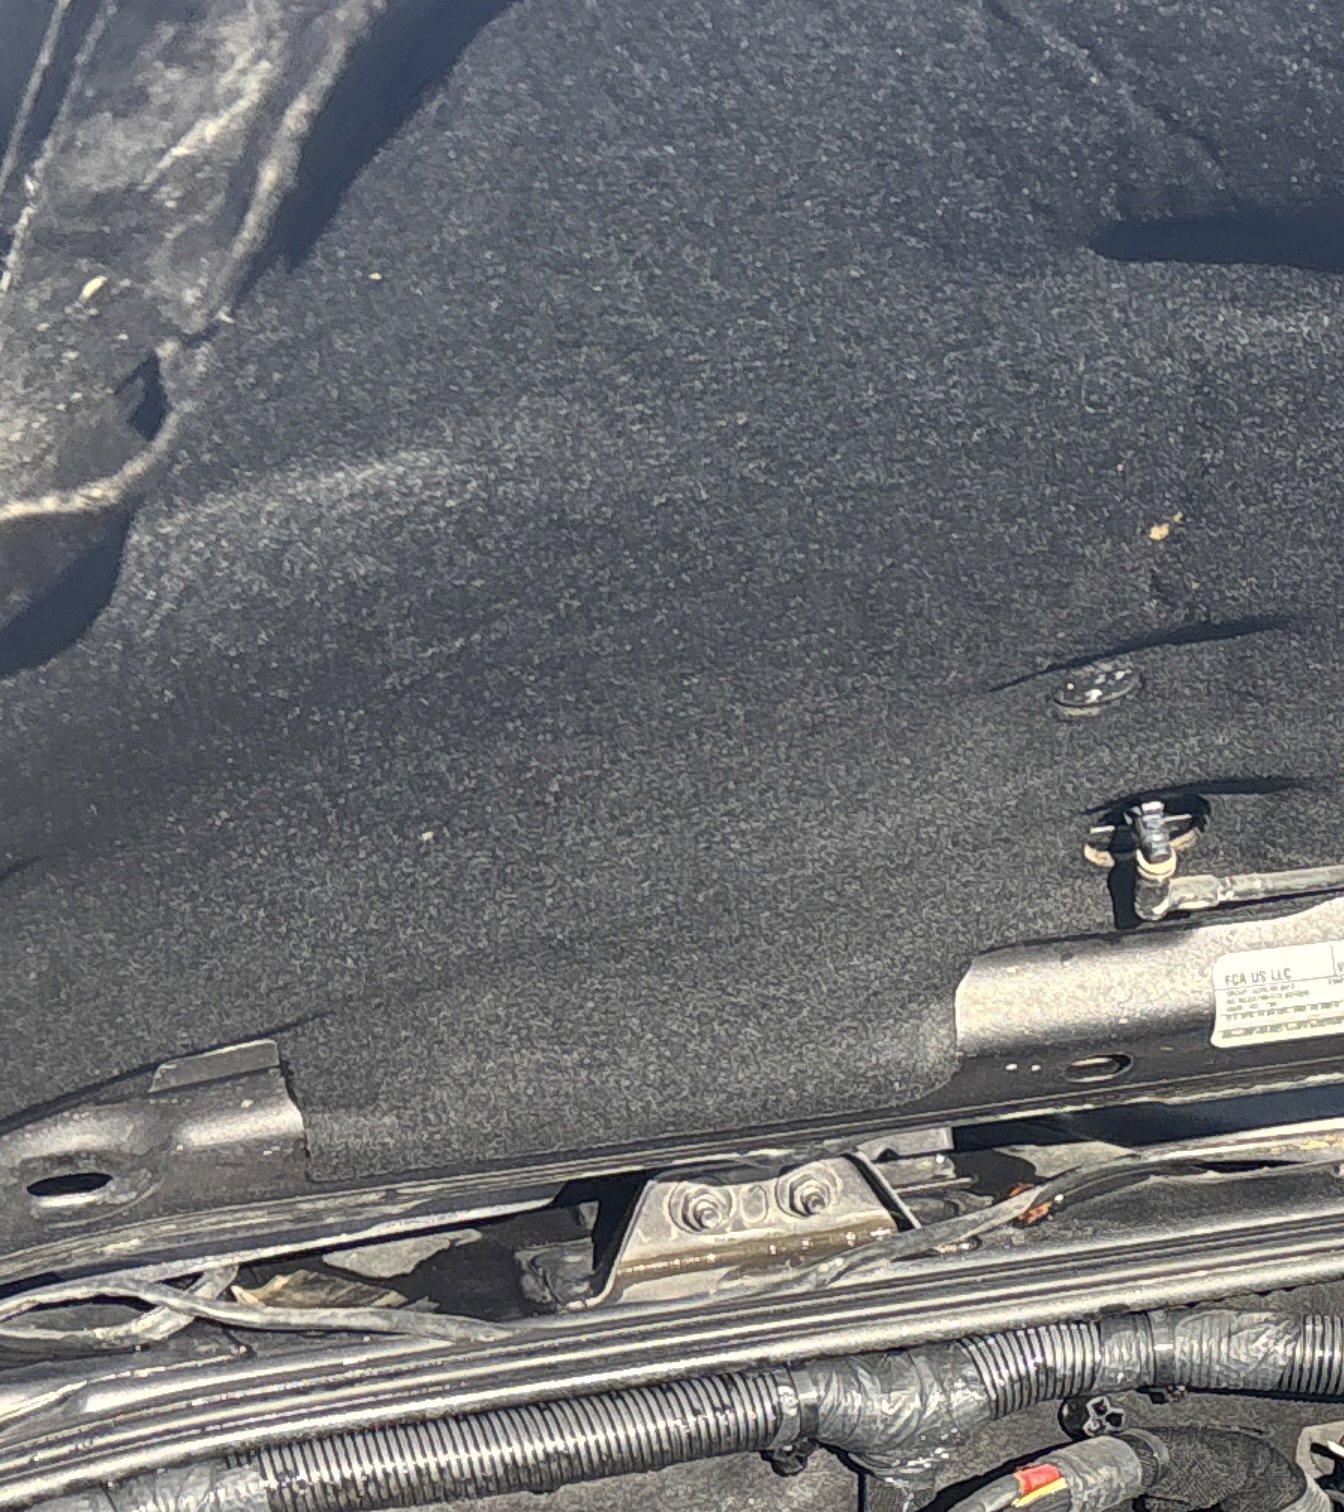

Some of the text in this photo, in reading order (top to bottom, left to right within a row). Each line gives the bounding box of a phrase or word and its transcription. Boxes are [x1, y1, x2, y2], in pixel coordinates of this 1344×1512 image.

[1225, 967, 1291, 987] FCA US LLC
